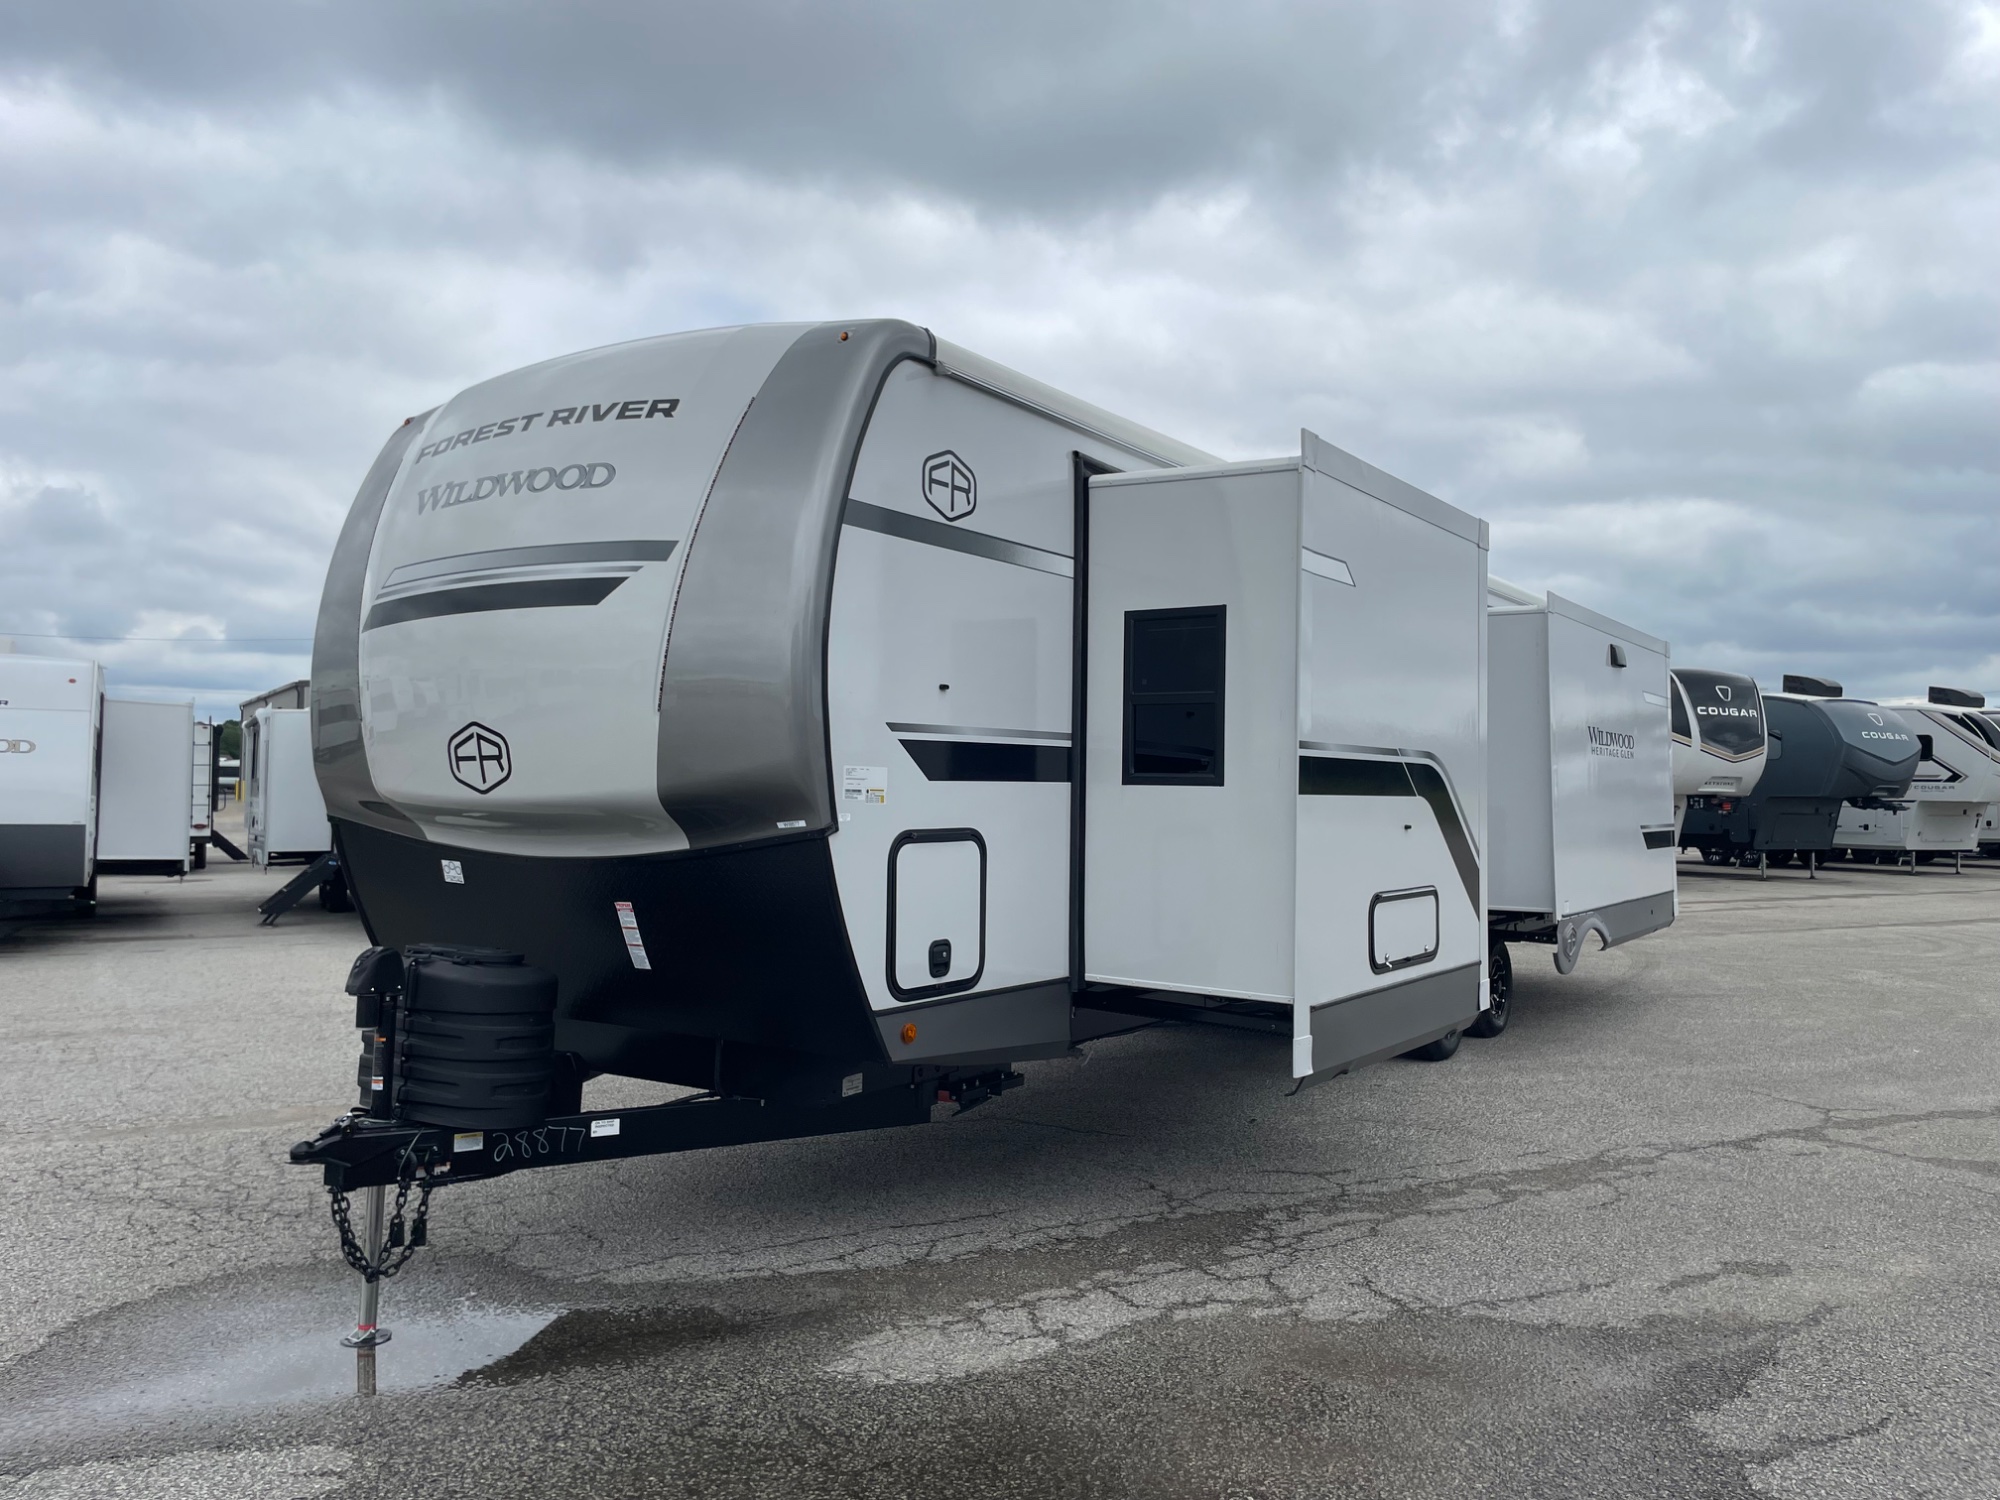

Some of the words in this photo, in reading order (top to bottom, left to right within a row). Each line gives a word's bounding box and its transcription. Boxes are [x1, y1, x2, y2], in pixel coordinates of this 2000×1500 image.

[415, 412, 544, 464] FOREST
[546, 398, 680, 428] RIVER
[418, 462, 617, 515] WILDWOOD
[1697, 706, 1758, 718] COUGAR
[1587, 726, 1634, 749] WILDWOOD
[1861, 731, 1909, 741] COUGAR
[1591, 746, 1619, 757] HERITAGE
[1620, 749, 1634, 759] GLEN
[492, 1125, 586, 1162] 28877
